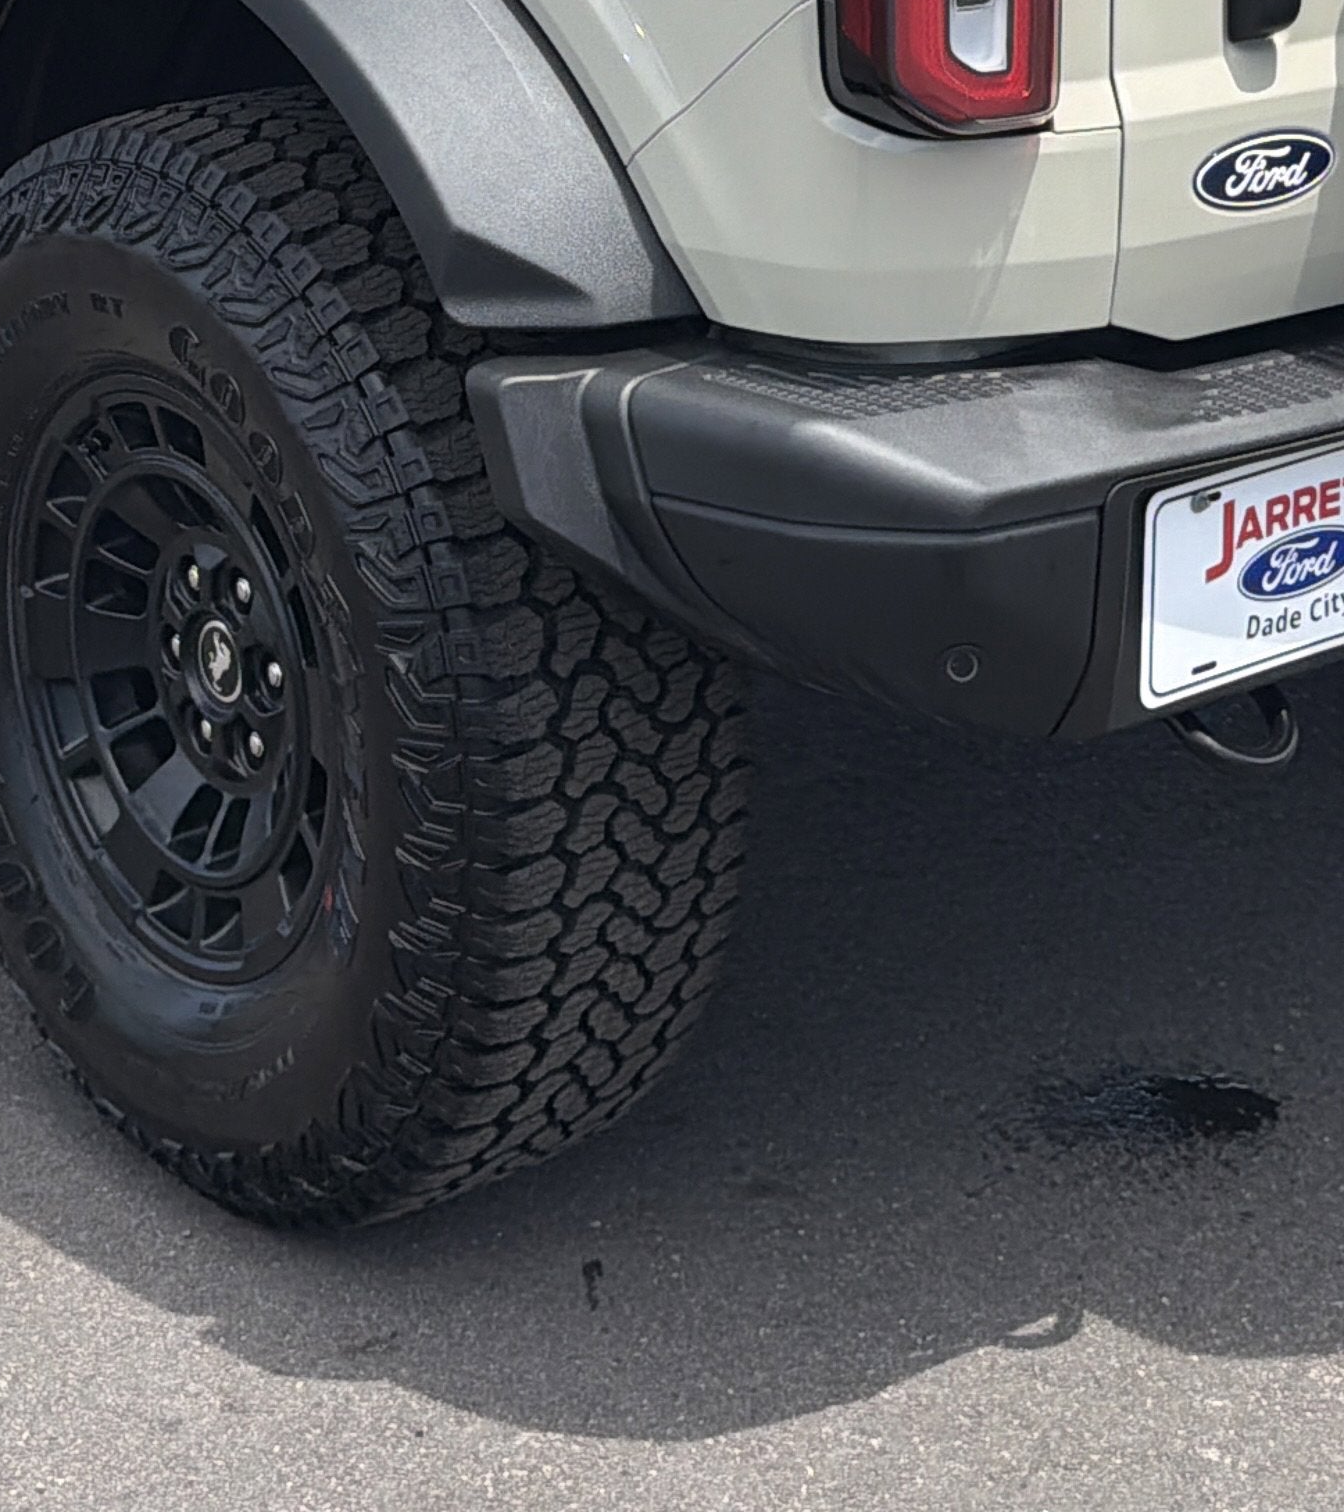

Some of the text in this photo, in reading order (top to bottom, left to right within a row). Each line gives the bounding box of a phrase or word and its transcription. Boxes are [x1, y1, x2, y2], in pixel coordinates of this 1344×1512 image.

[1224, 145, 1311, 197] Ford
[1261, 536, 1339, 592] Ford
[1246, 607, 1302, 640] Dade
